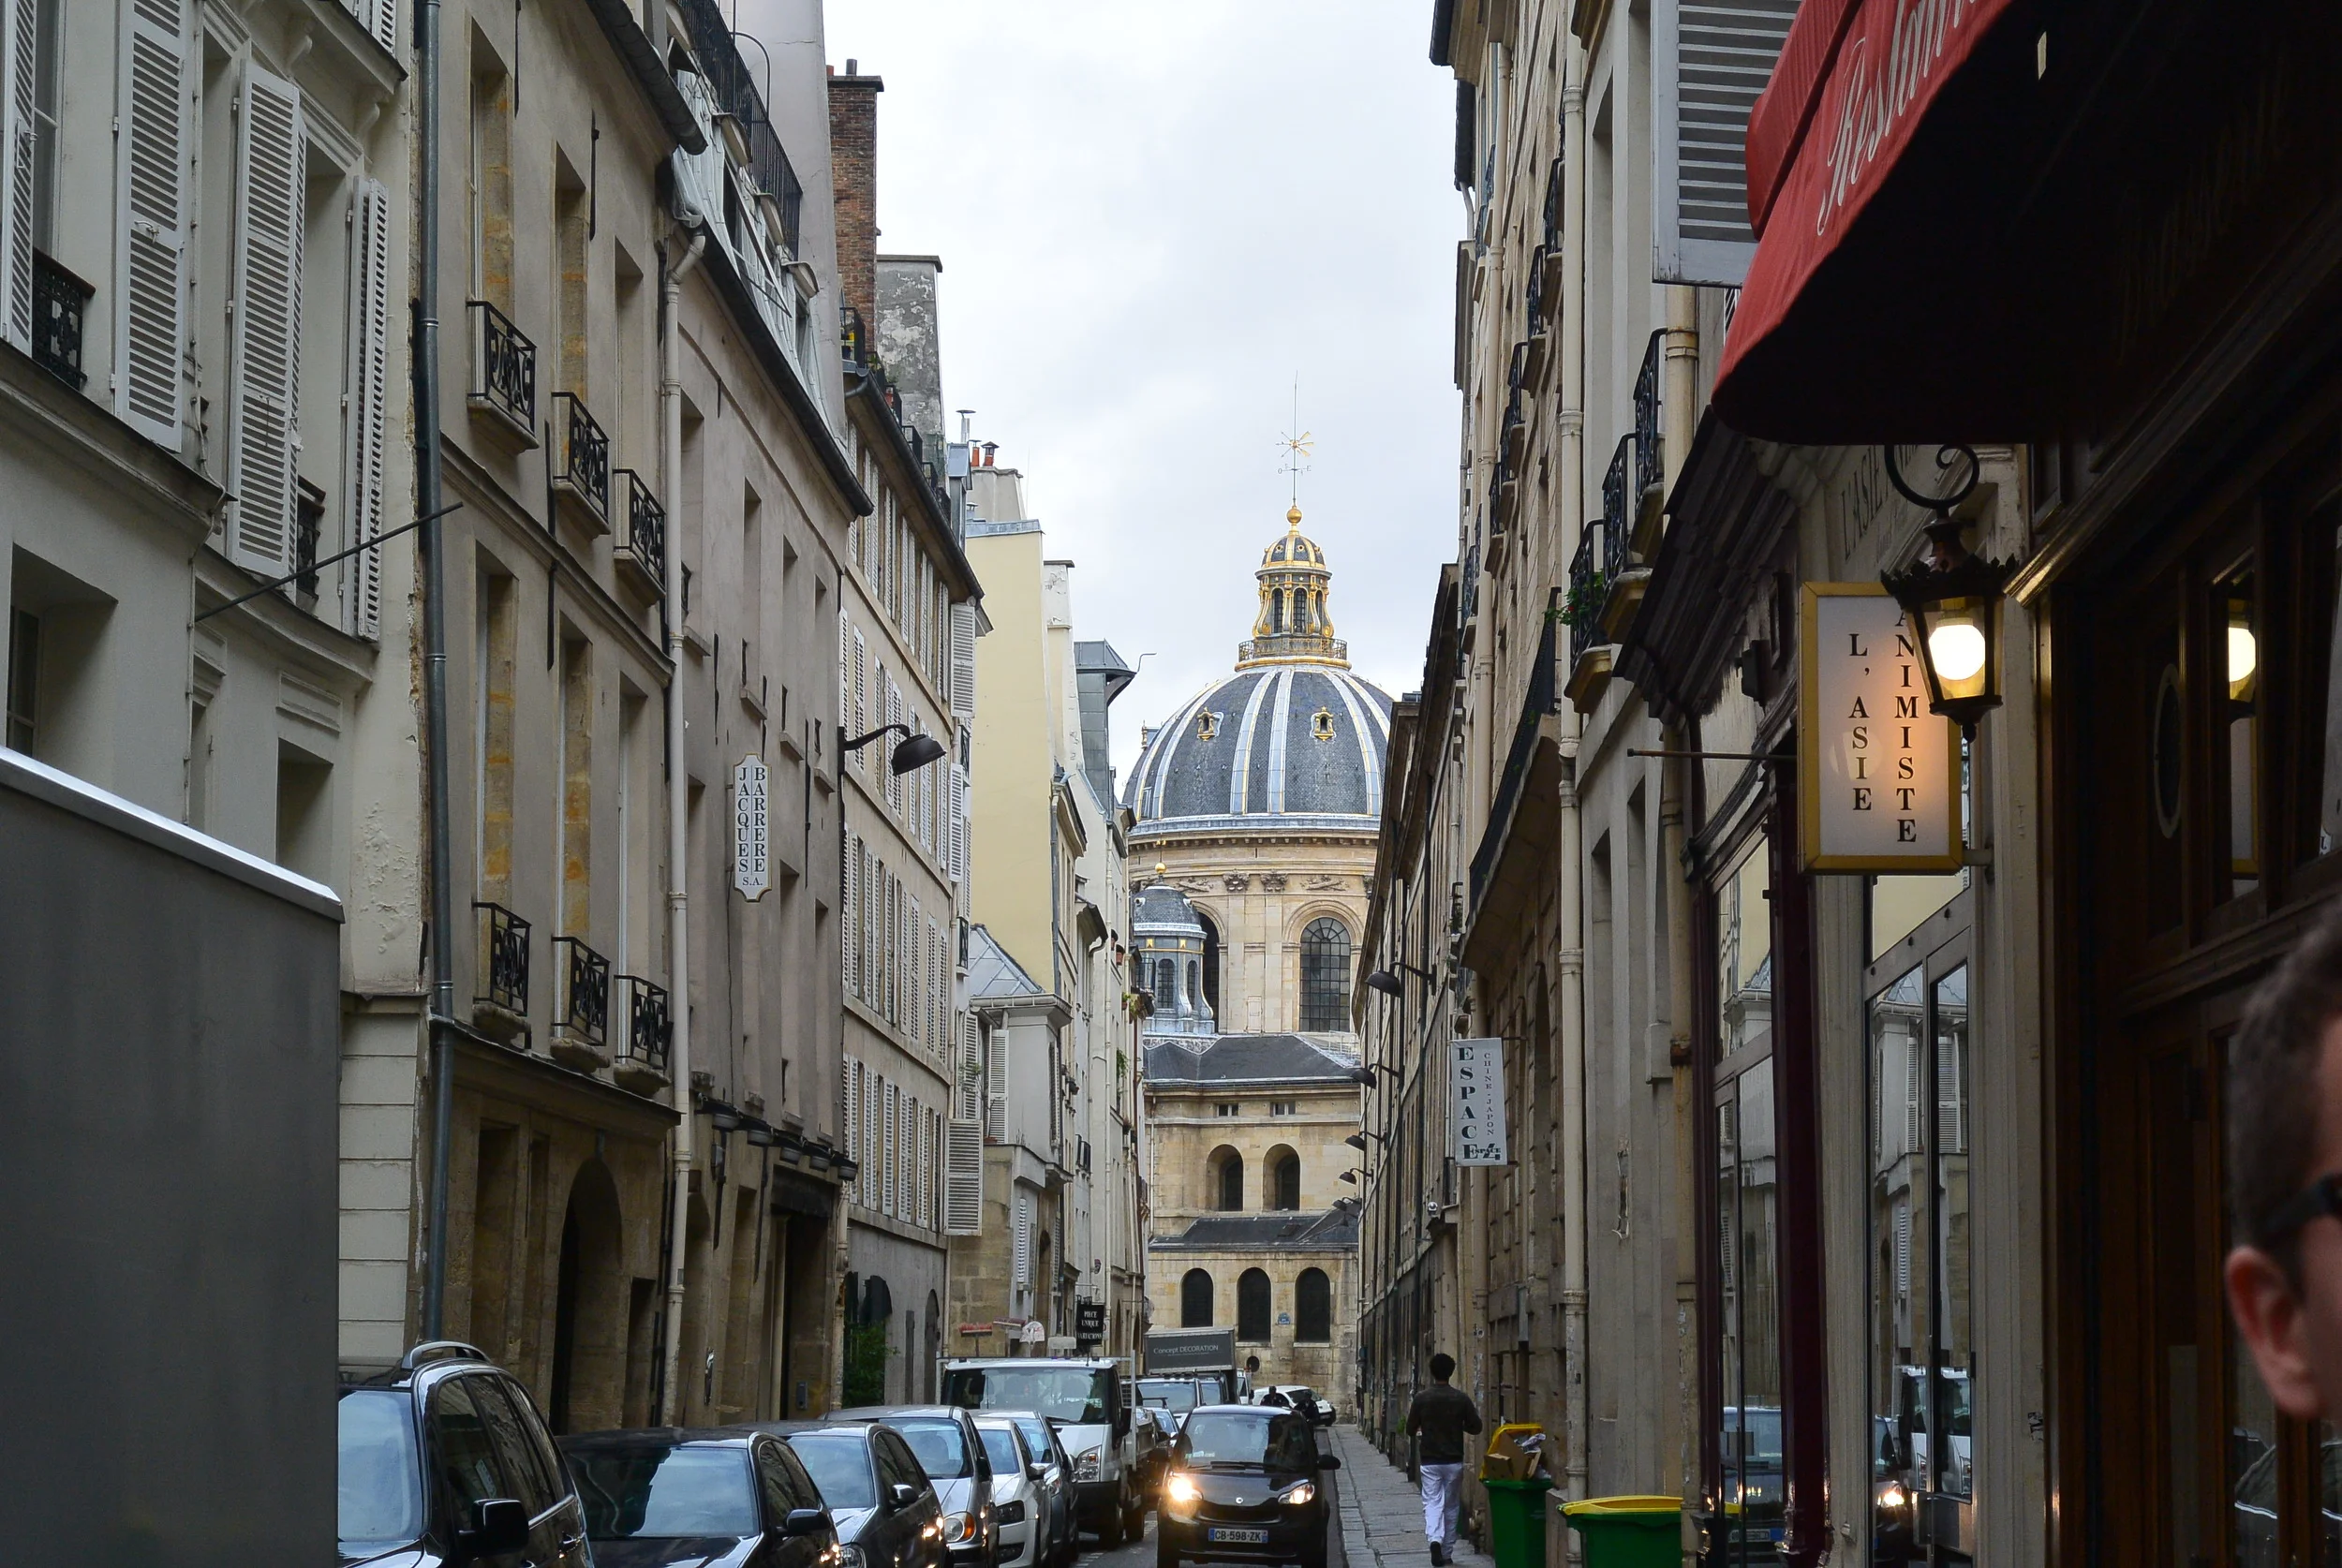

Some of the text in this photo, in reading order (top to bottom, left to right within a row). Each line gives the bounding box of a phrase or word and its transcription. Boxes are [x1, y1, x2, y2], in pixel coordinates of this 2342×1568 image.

[1848, 633, 1873, 811] L'ASIE
[737, 767, 750, 873] JACQUES
[753, 767, 766, 873] BARRERE
[742, 877, 763, 886] S.A.
[1457, 1046, 1479, 1161] ESPACE
[1179, 1344, 1219, 1353] DECORATION
